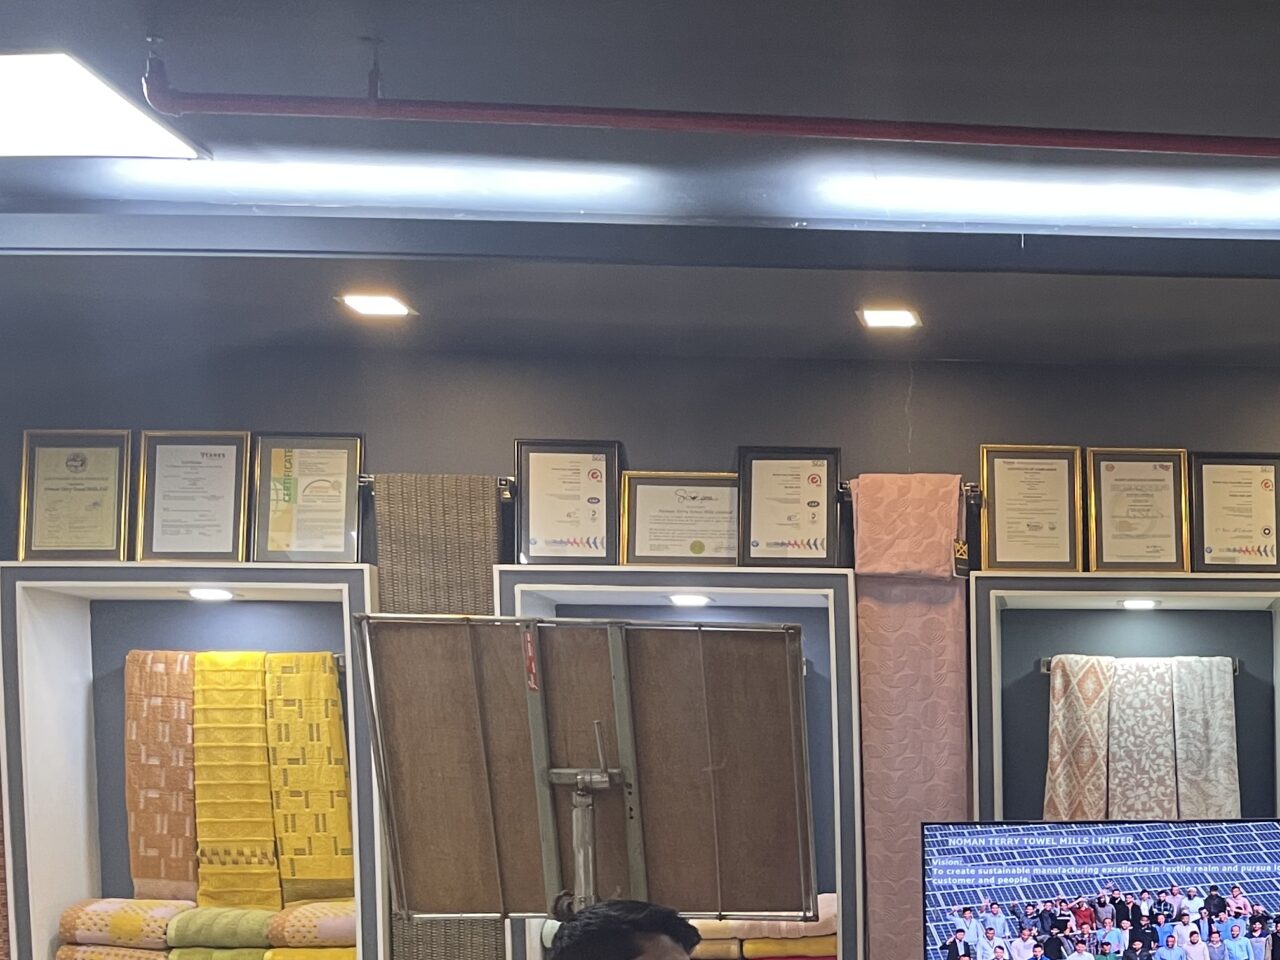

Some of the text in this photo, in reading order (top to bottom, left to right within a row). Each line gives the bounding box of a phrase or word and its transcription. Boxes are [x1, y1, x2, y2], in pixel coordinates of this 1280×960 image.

[283, 449, 293, 503] CERTIFICATE
[949, 836, 1134, 846] NOMAN TERRY TOWEL MILLS LIMITED
[978, 866, 1030, 874] sustainable
[1033, 866, 1099, 875] manufacturing
[1101, 865, 1148, 873] excellence
[1151, 864, 1160, 872] in
[1162, 864, 1191, 872] textile
[1193, 864, 1219, 872] realm
[1222, 864, 1238, 872] and
[1240, 865, 1271, 873] pursue
[978, 876, 995, 884] and
[998, 876, 1031, 885] people.
